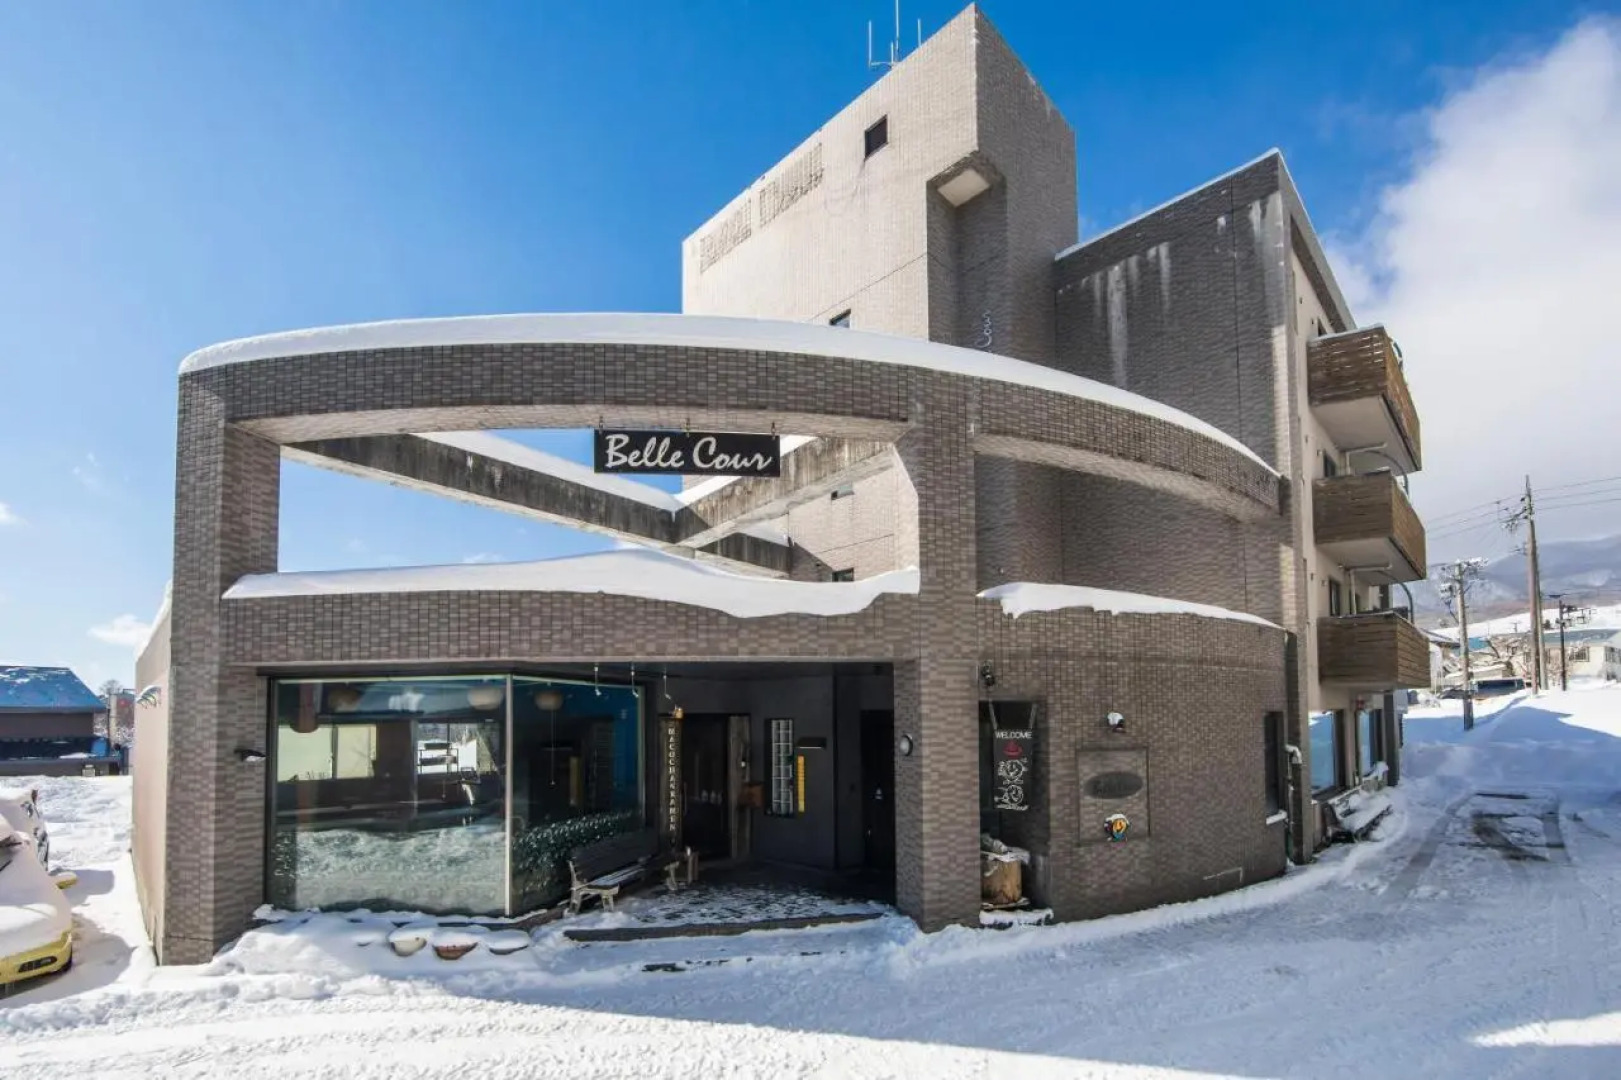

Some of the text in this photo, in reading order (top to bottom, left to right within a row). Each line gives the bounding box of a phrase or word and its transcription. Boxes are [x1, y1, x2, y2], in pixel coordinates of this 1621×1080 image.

[604, 433, 772, 471] Belle Cour
[994, 731, 1033, 739] WELCOME
